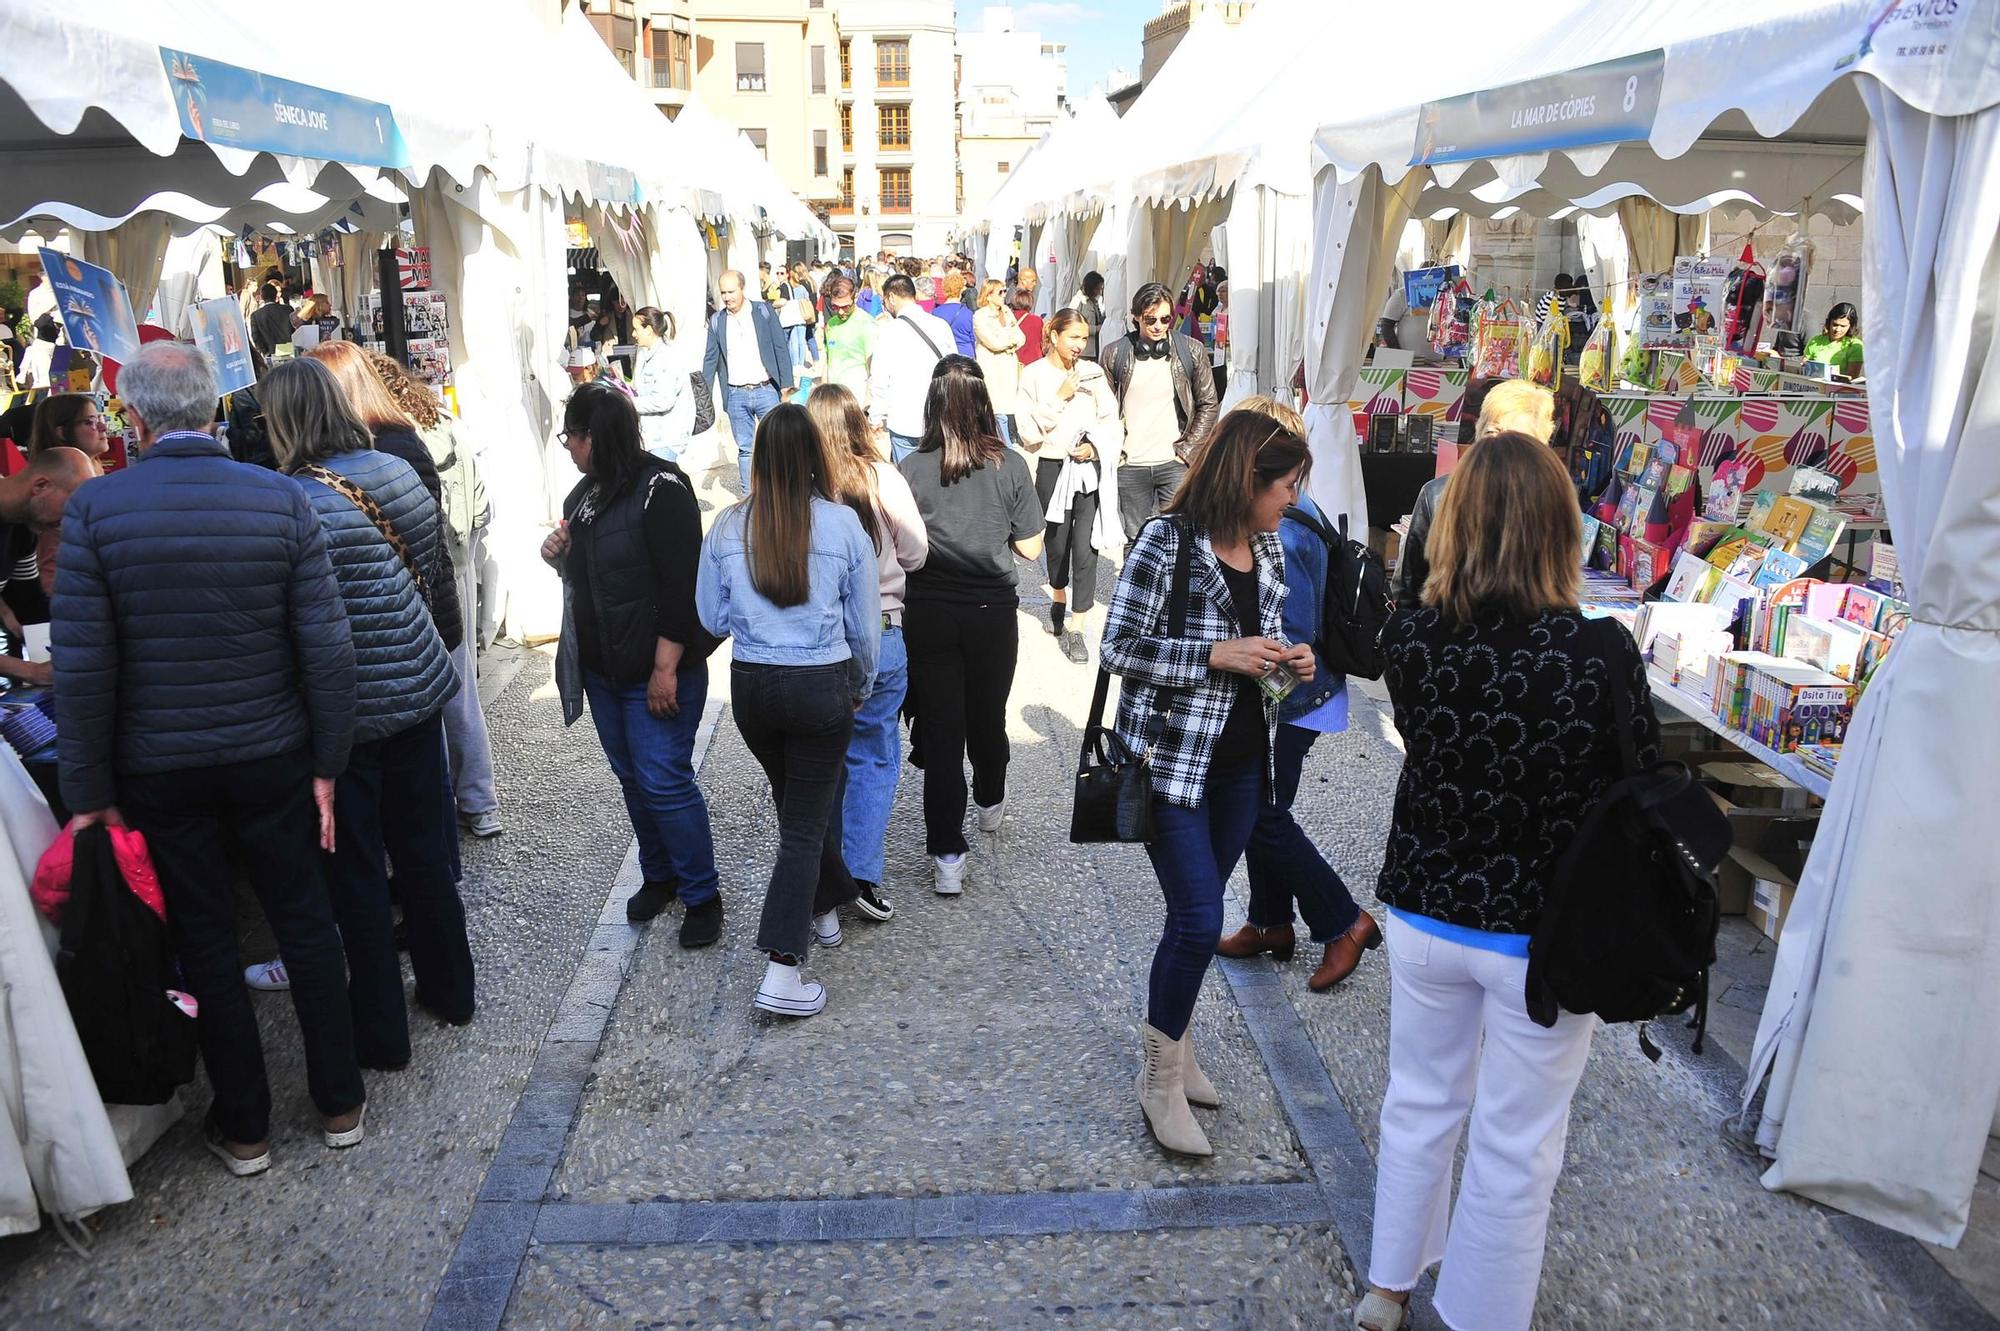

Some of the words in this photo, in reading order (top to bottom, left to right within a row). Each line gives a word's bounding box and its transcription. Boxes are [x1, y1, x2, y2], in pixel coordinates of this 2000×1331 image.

[1622, 75, 1639, 113] 8
[274, 97, 308, 128] SÉNECA
[307, 108, 329, 131] JOVE
[1511, 111, 1524, 128] LA
[1524, 107, 1545, 126] MAR
[1546, 105, 1560, 122] DE
[374, 116, 385, 145] 1
[1802, 691, 1824, 700] Osito
[1826, 691, 1844, 700] Tito
